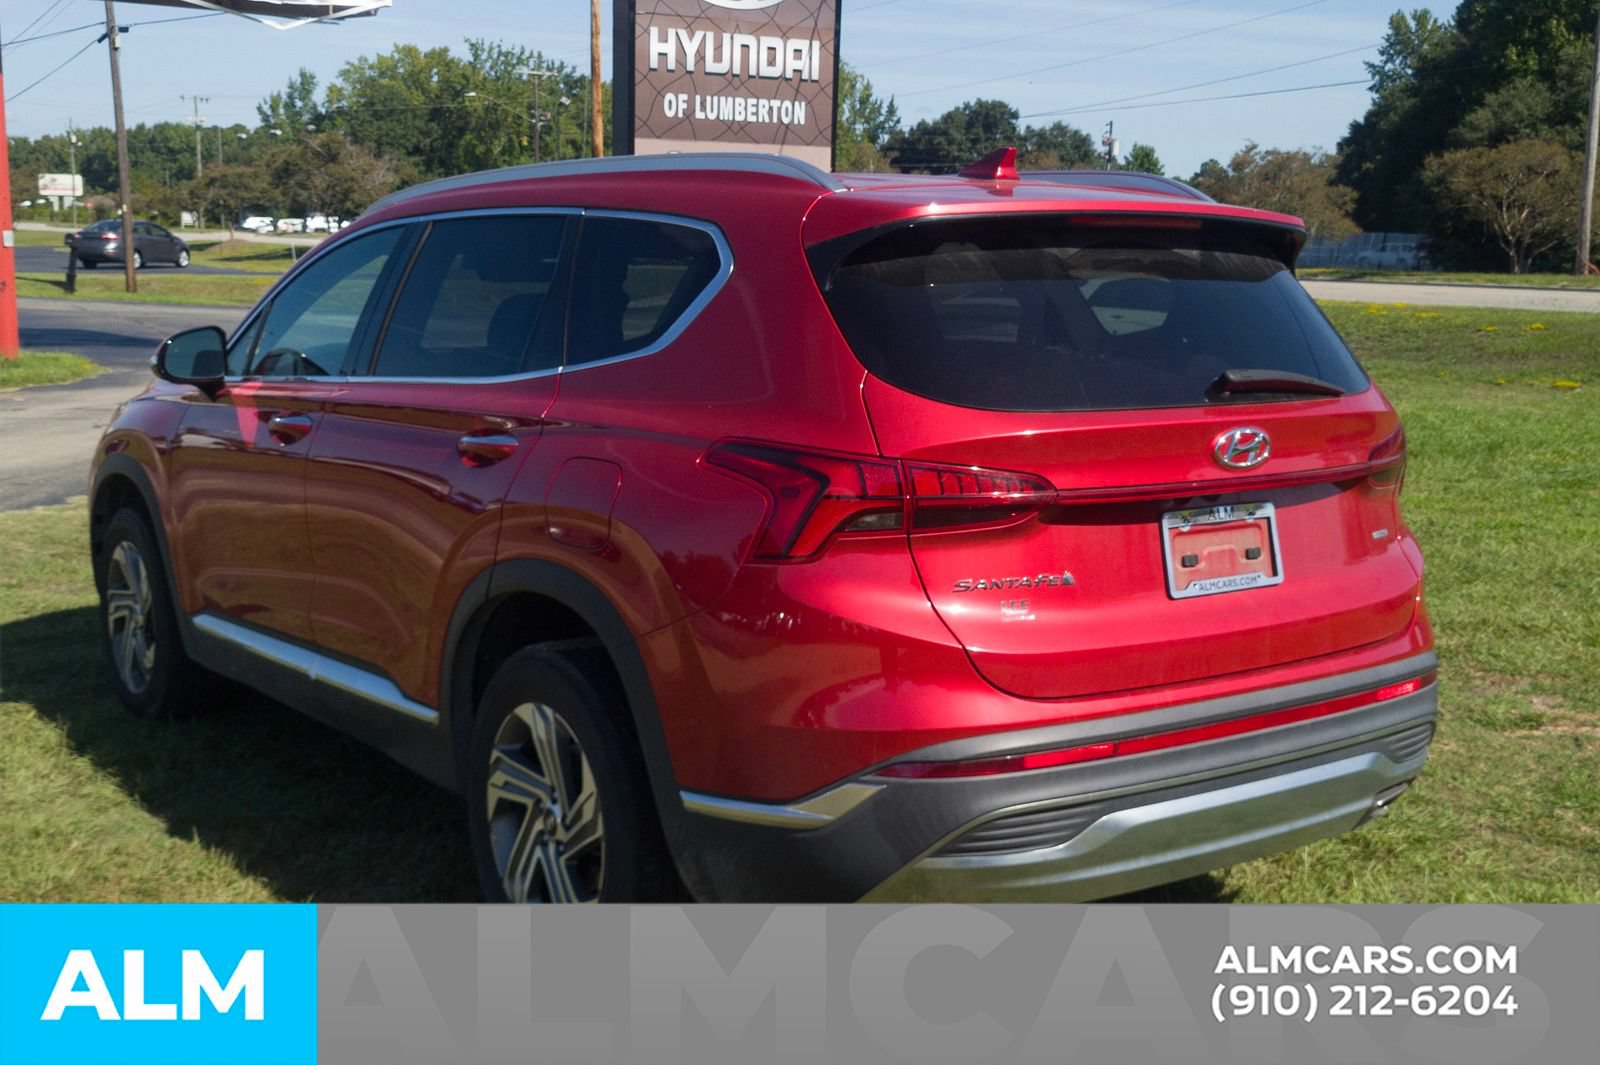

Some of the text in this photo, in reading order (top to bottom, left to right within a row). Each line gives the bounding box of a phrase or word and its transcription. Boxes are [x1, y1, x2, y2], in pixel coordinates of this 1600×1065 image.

[649, 26, 821, 82] HYUNDAI
[663, 93, 807, 126] OF LUMBERTON
[1208, 506, 1236, 521] ALM
